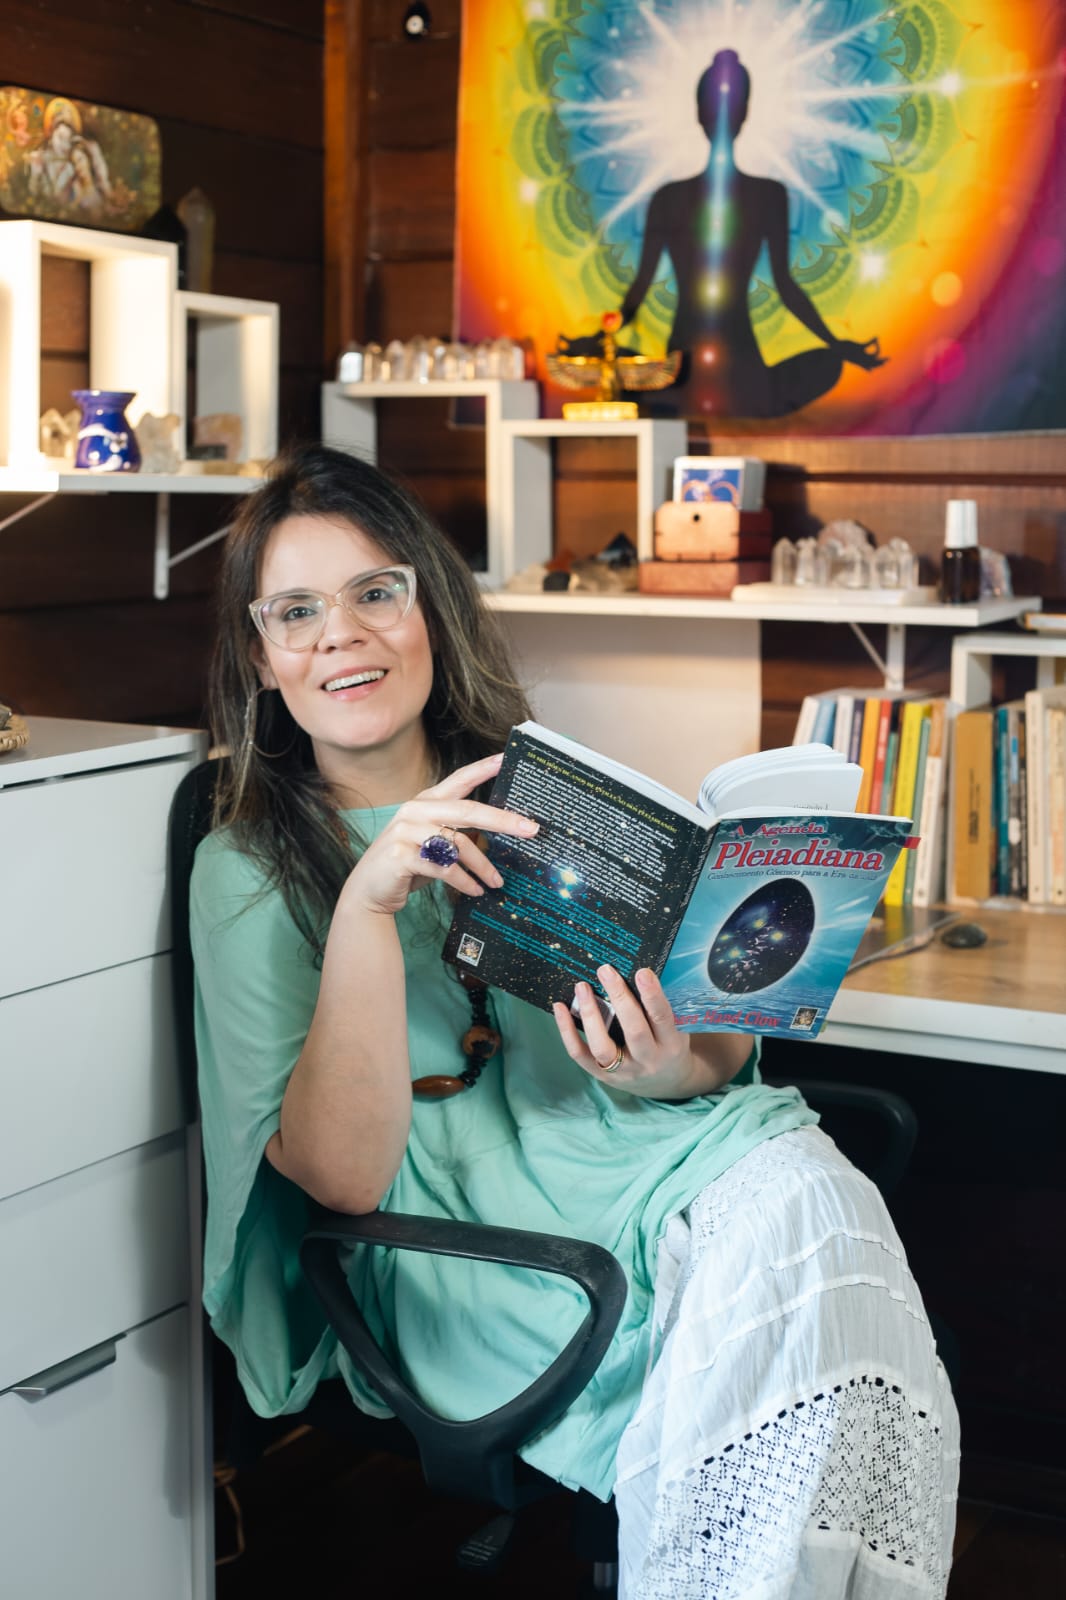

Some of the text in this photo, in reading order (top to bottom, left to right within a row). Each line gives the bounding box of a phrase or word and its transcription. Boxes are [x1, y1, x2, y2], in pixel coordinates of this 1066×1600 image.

[728, 821, 825, 837] A Agenda
[710, 838, 884, 871] Pleiadiana
[766, 867, 800, 877] Cósmico
[801, 870, 822, 878] para
[830, 870, 847, 878] Era
[702, 1009, 742, 1025] Hand
